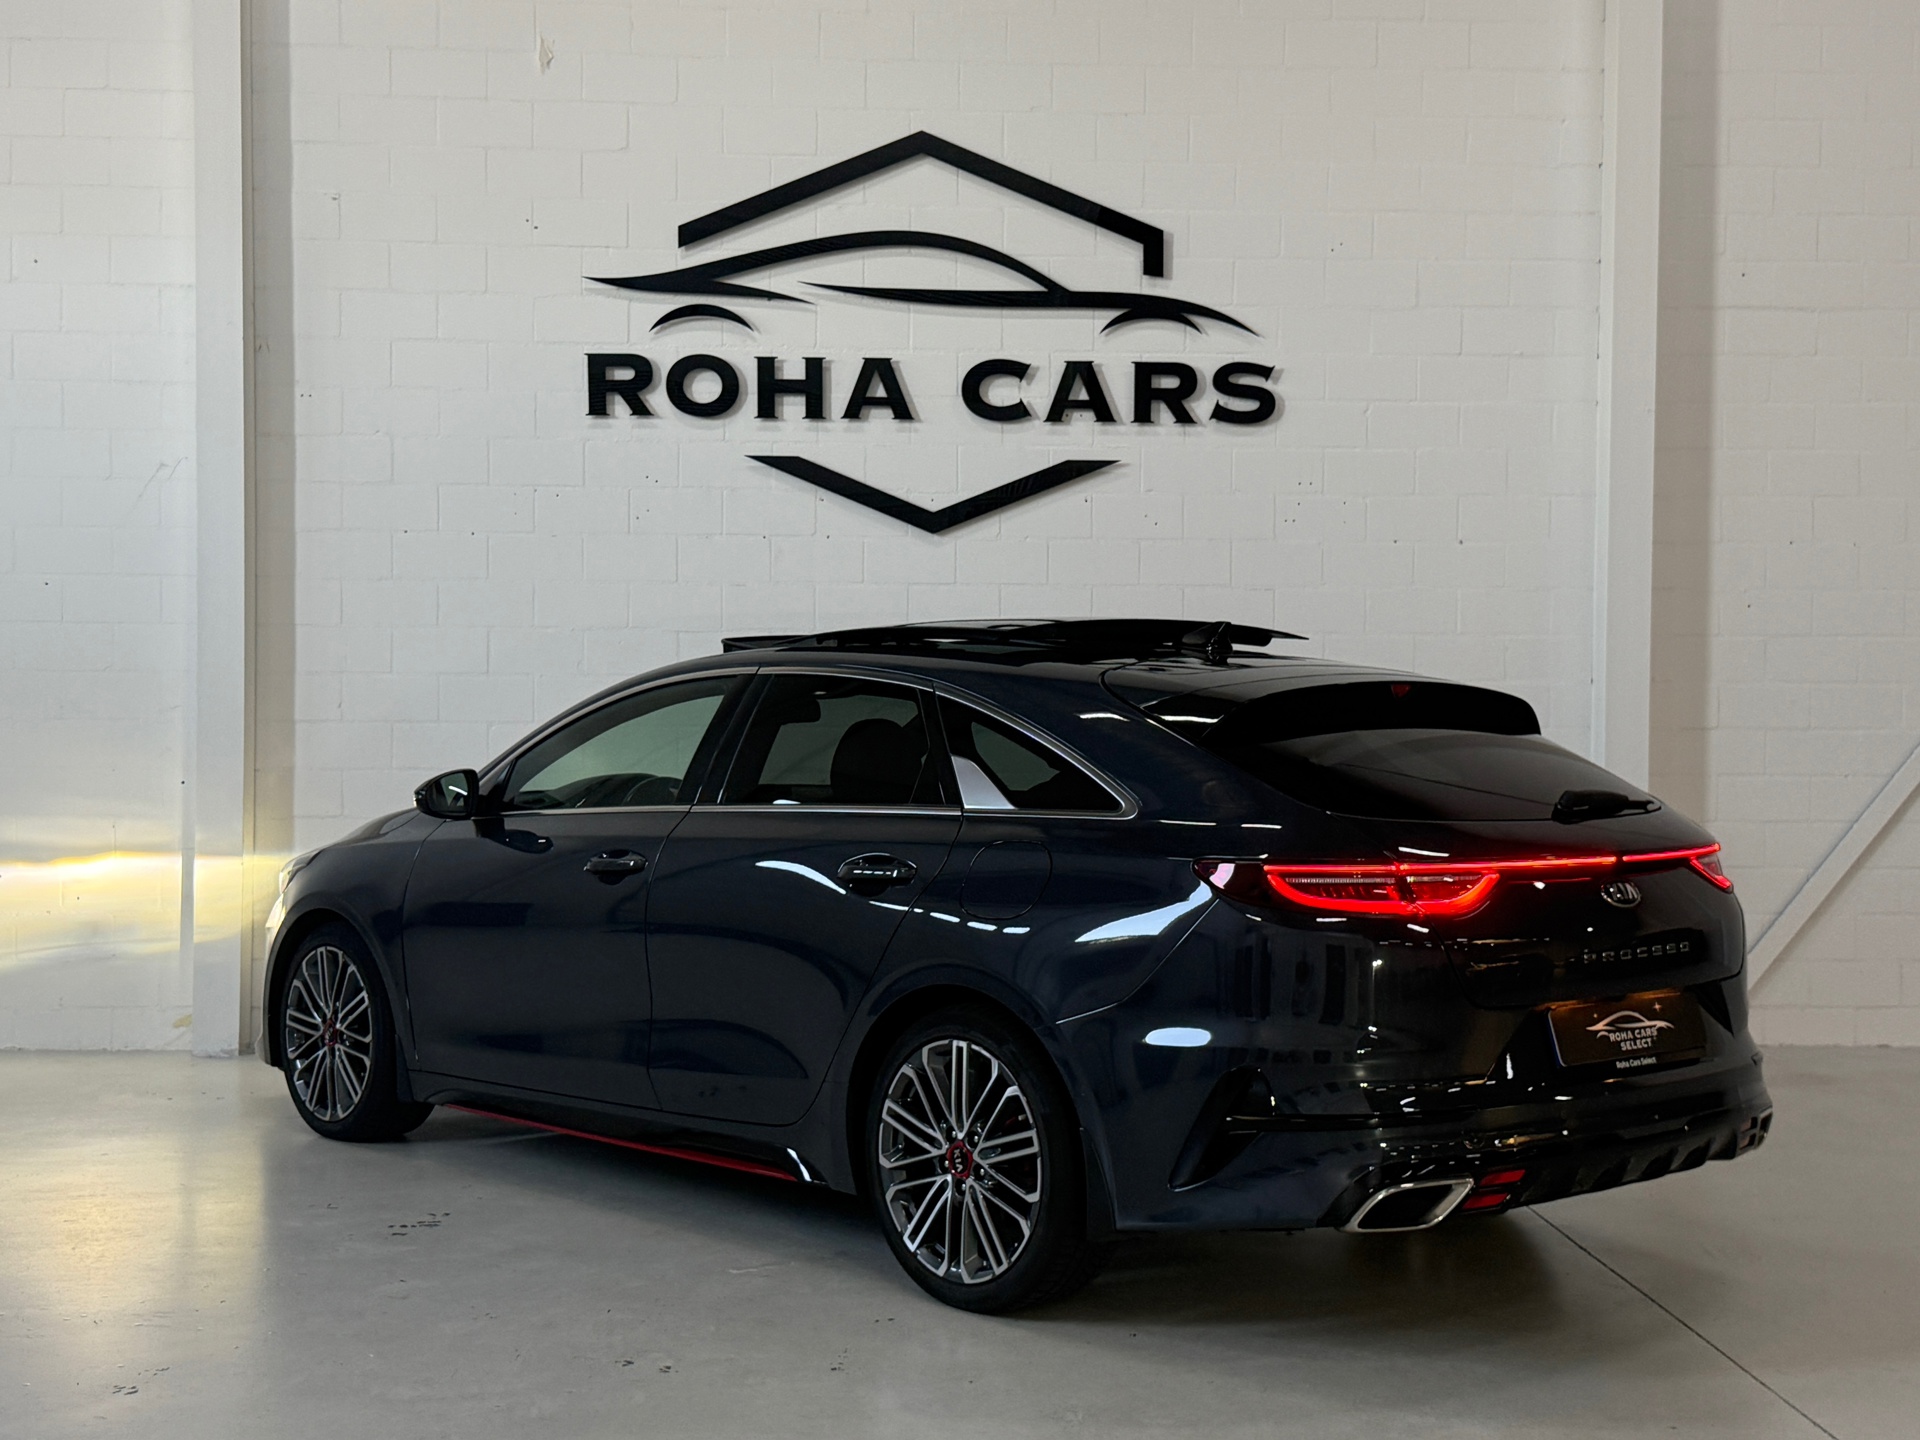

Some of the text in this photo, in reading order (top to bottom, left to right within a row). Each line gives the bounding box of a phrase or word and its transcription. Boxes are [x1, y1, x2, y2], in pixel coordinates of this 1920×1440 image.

[586, 354, 1275, 425] ROHA CARS
[1609, 1027, 1658, 1042] ROHA CARS
[1620, 1038, 1652, 1051] SELECT
[953, 1149, 964, 1172] KIA
